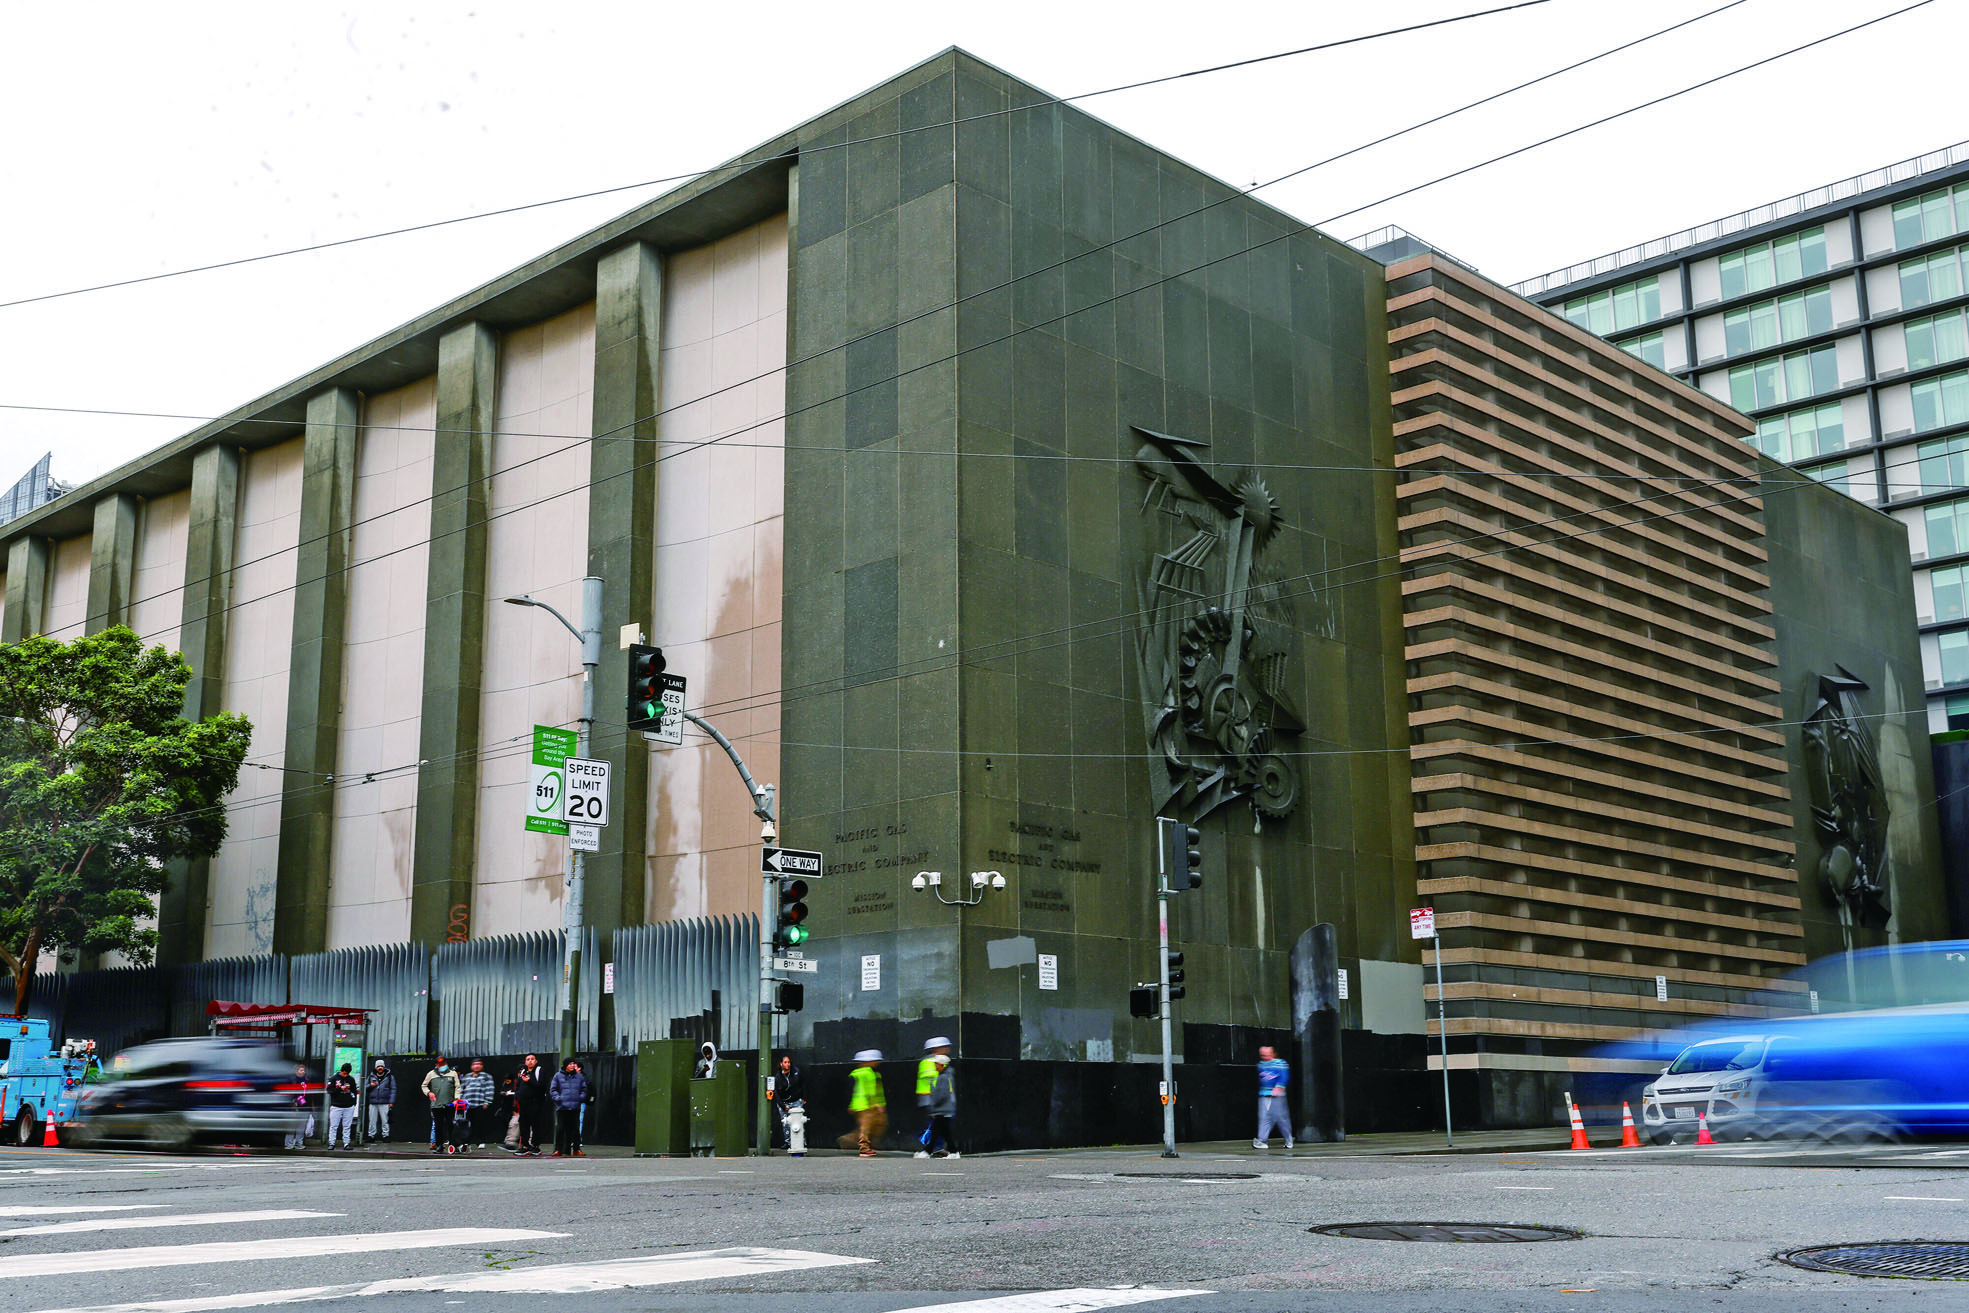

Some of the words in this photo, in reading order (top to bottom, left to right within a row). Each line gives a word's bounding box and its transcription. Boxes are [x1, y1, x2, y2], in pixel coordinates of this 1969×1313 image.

[668, 679, 684, 688] LANE
[663, 693, 680, 703] SES
[664, 705, 678, 715] XIS
[569, 763, 606, 777] SPEED
[536, 785, 554, 798] 511
[571, 778, 602, 792] LIMIT
[568, 794, 603, 819] 20
[576, 829, 593, 837] PHOTO
[834, 828, 878, 844] PACIFIC
[886, 823, 908, 836] GAS
[571, 837, 597, 847] ENFORCED
[780, 855, 797, 868] ONE
[799, 858, 817, 870] WAY
[821, 859, 867, 877] LECTRIC
[874, 850, 929, 869] COMPANY
[988, 849, 1042, 867] ELECTRIC
[1050, 858, 1102, 875] COMPANY
[783, 960, 795, 969] 8th
[798, 961, 807, 970] St
